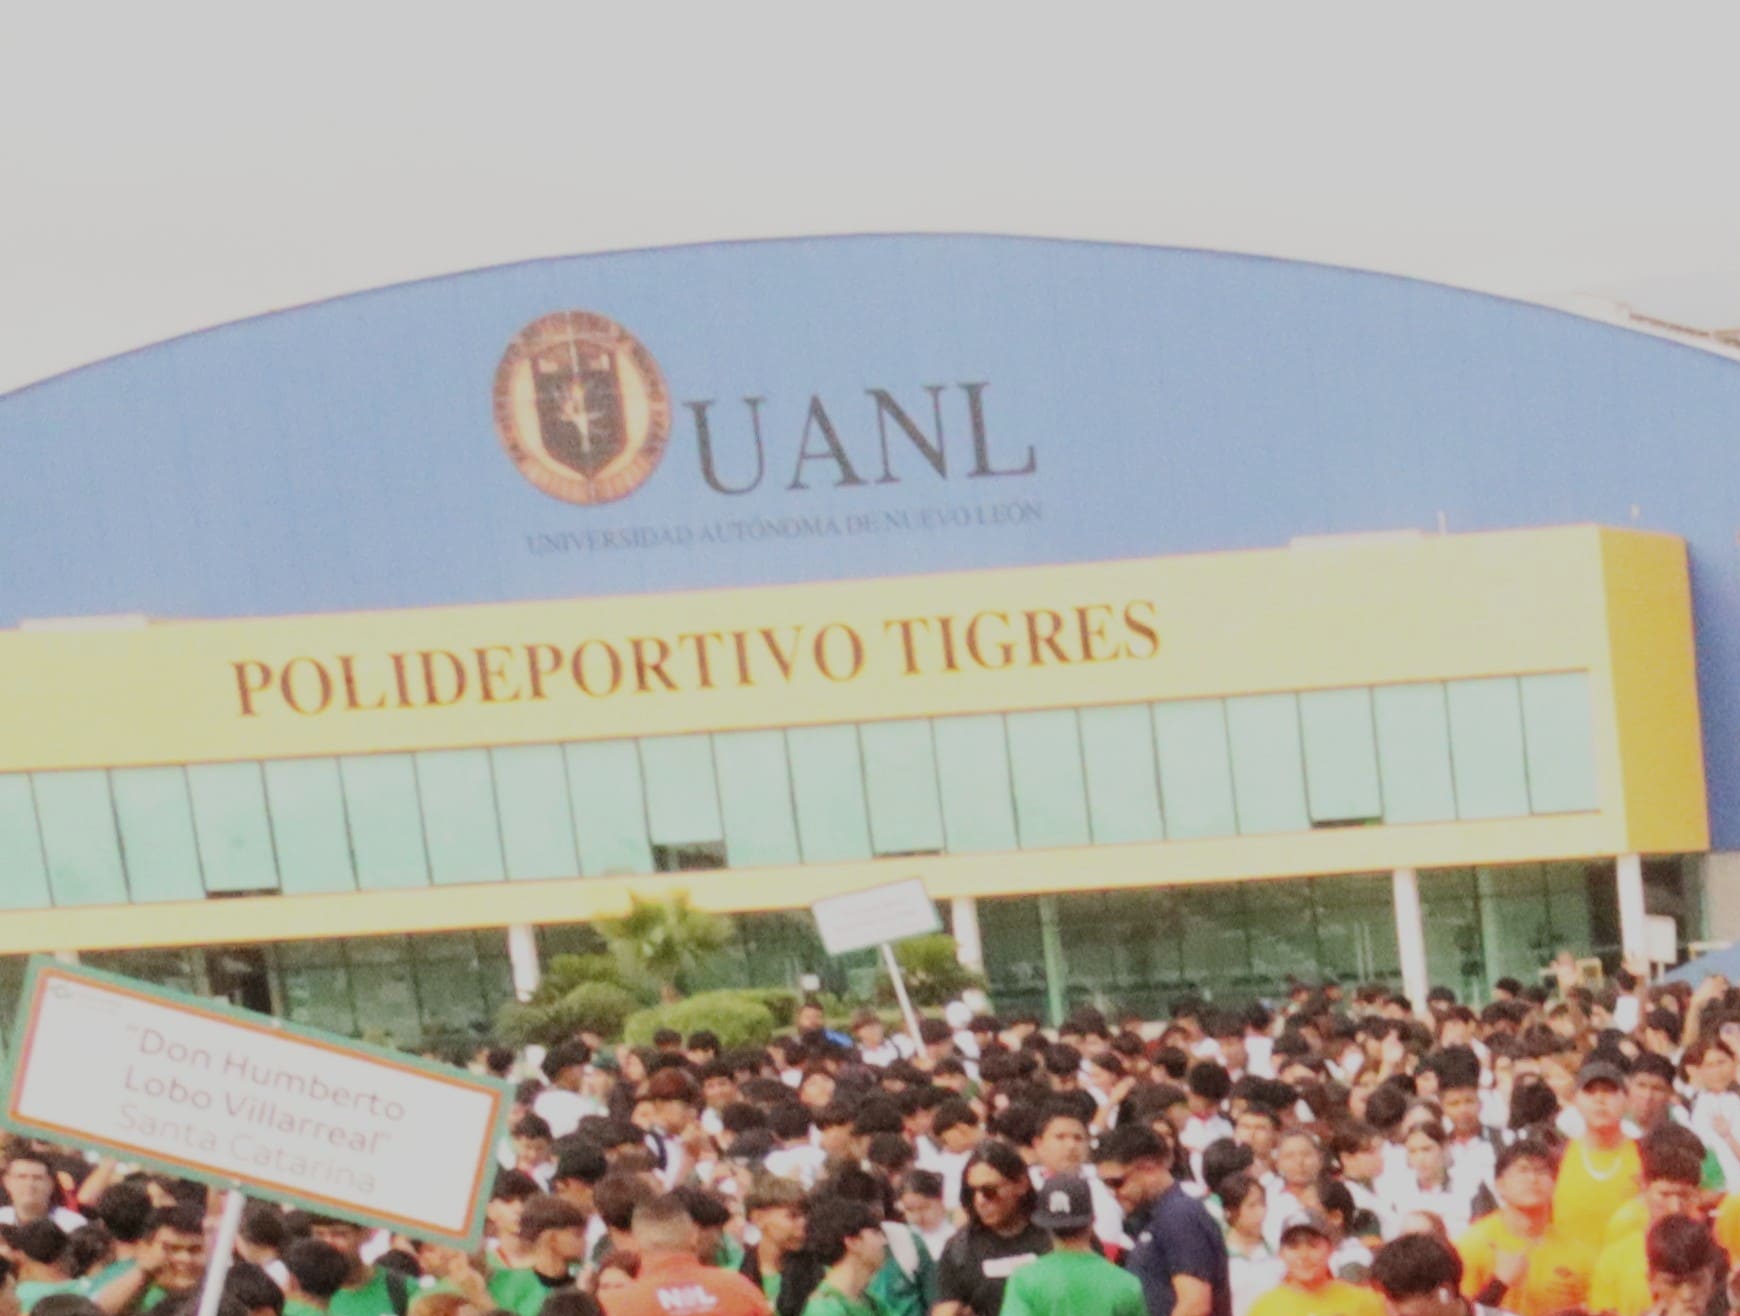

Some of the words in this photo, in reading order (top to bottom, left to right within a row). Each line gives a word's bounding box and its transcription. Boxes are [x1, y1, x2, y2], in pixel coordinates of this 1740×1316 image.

[682, 380, 1038, 496] UANL
[527, 521, 693, 557] UNIVERSIDAD
[847, 513, 881, 538] DE
[884, 506, 972, 535] NUEVO
[229, 622, 866, 718] POLIDEPORTIVO
[884, 600, 1161, 677] TIGRES
[124, 1065, 214, 1110] Lobo
[222, 1048, 406, 1122] Humberto
[119, 1105, 219, 1152] Santa
[230, 1128, 377, 1195] Catarina
